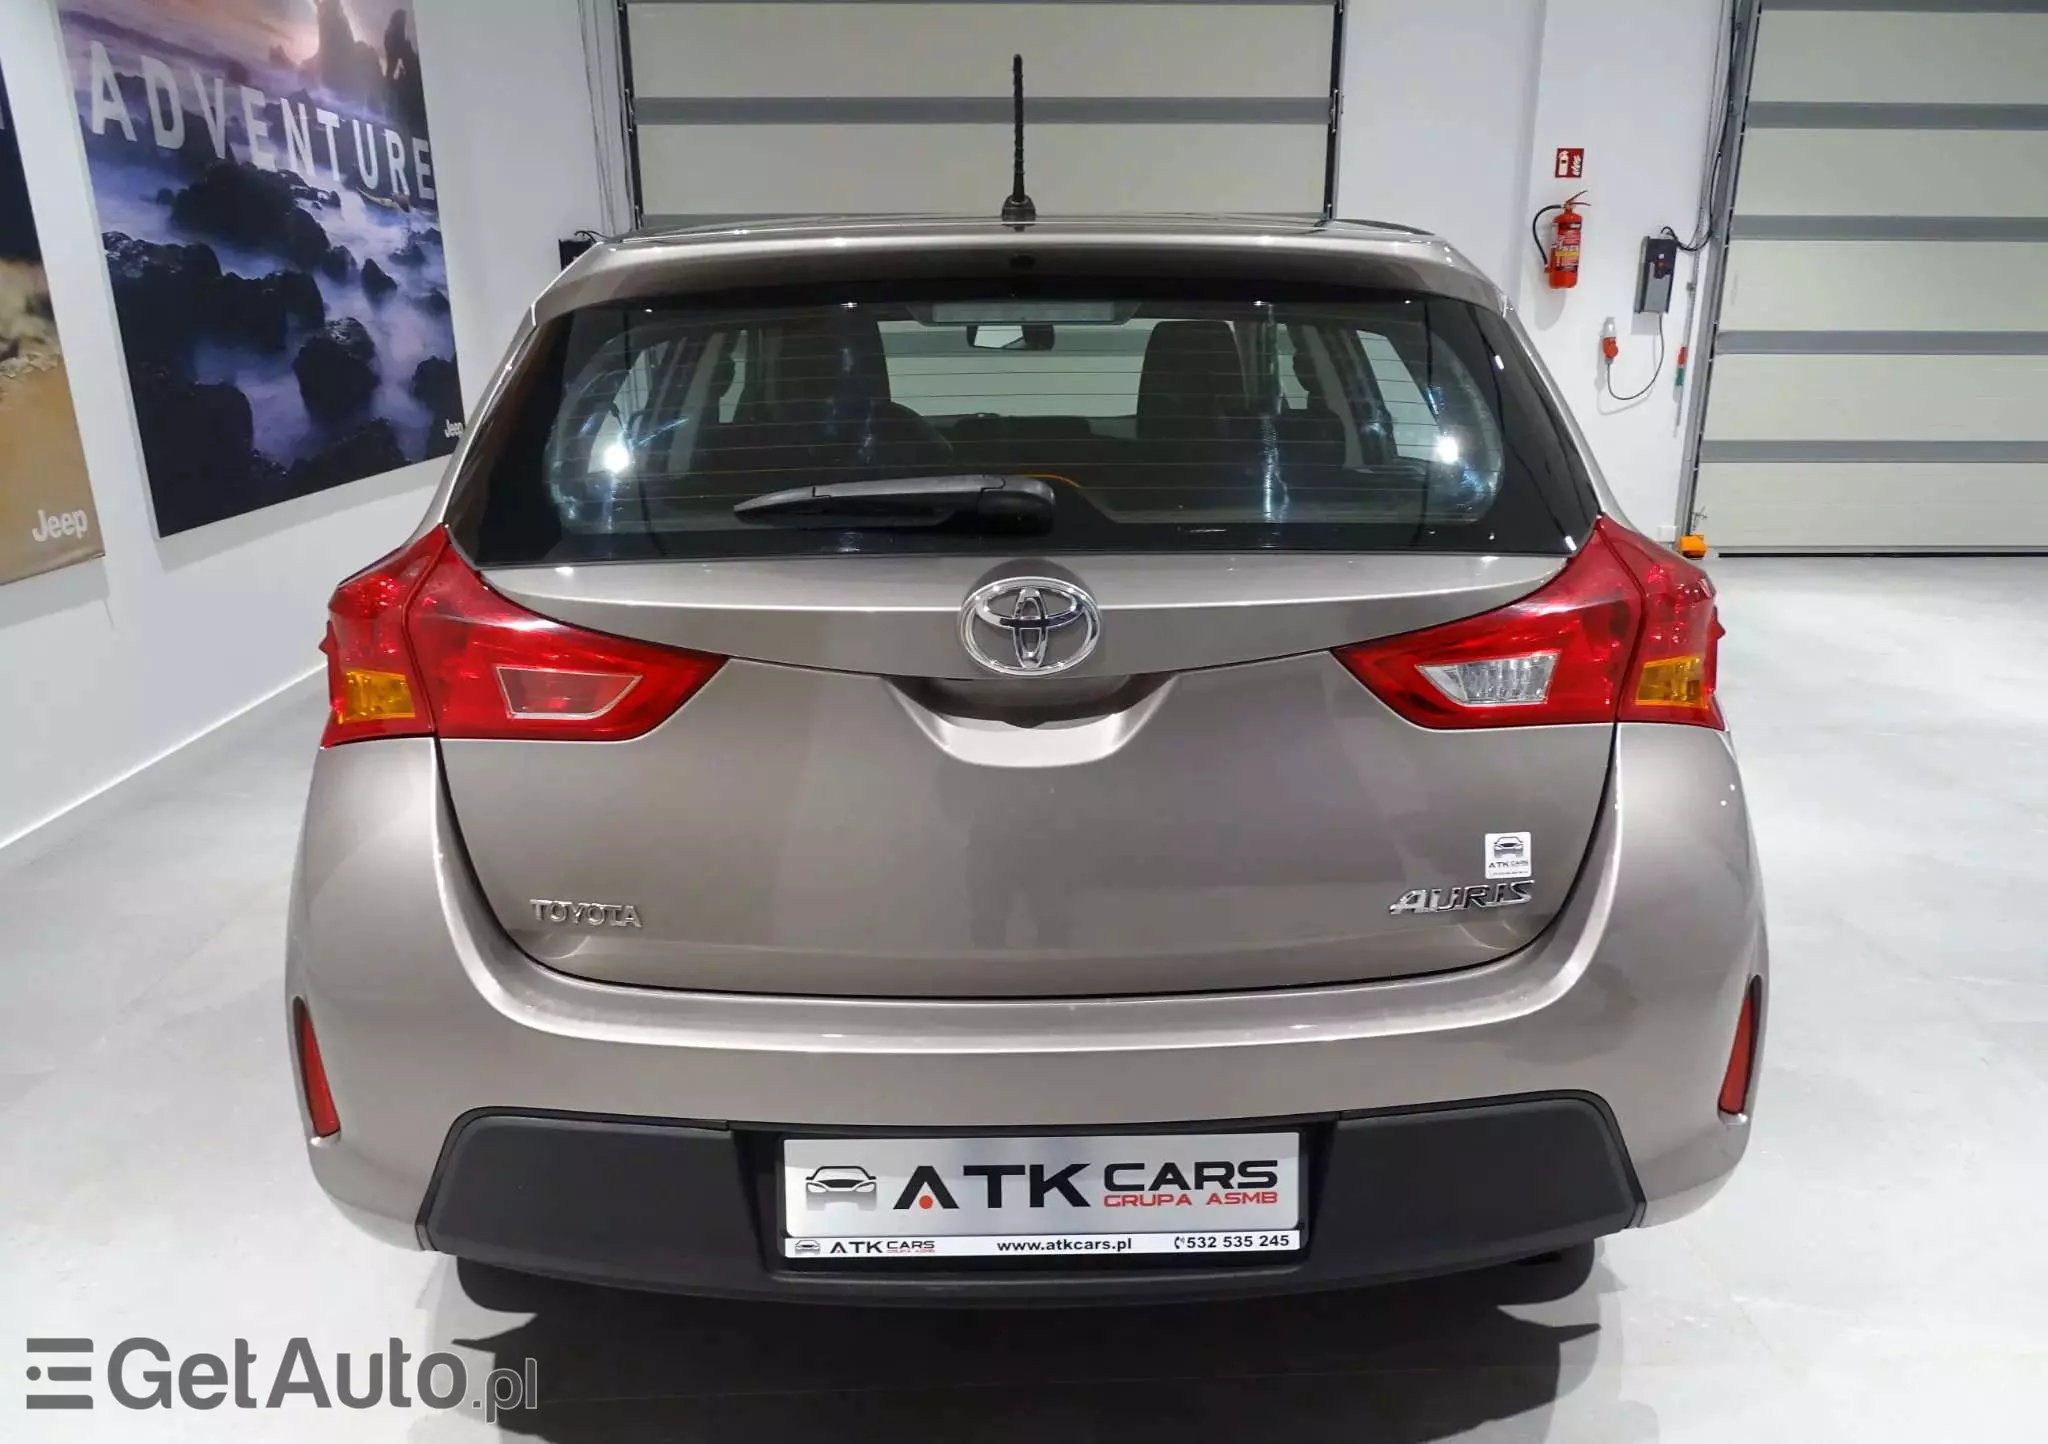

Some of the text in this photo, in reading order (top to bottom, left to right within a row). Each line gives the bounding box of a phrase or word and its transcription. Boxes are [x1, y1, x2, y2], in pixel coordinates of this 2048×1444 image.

[90, 40, 436, 201] ADVENTURE
[444, 418, 464, 438] Jeep
[32, 509, 88, 542] Jeep
[1389, 880, 1535, 915] AURIS
[530, 899, 642, 928] TOYOTA
[893, 1160, 1278, 1210] ATK CARS
[1104, 1192, 1278, 1208] GRUPA ASMB
[830, 1234, 1290, 1254] ATK CARS www.atkcars.pl 532 535 245
